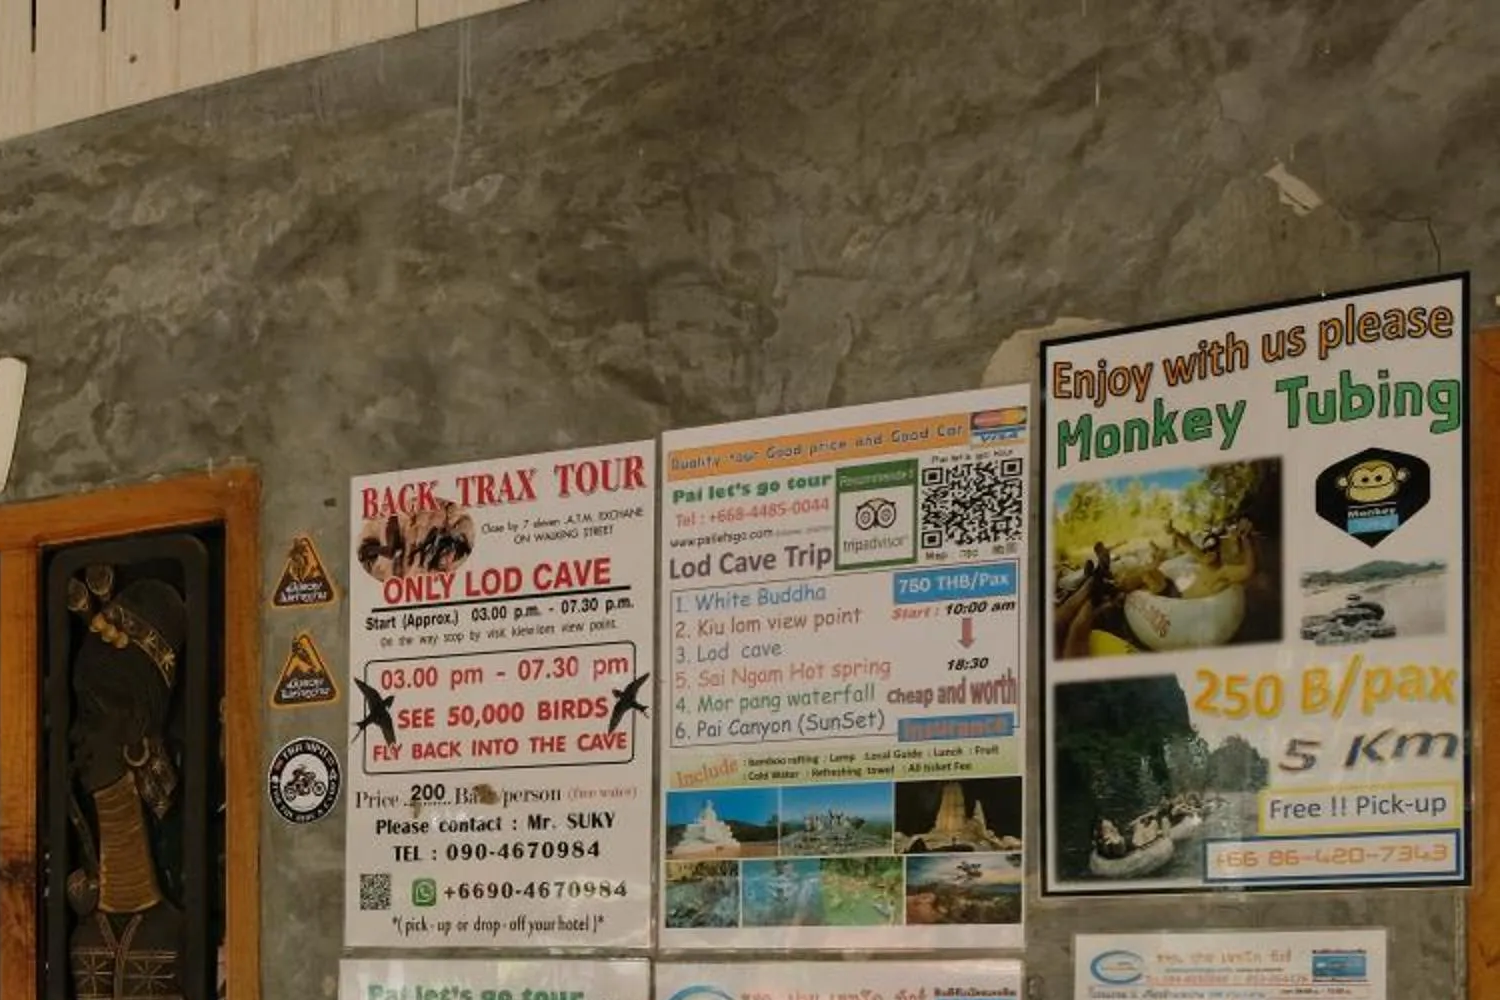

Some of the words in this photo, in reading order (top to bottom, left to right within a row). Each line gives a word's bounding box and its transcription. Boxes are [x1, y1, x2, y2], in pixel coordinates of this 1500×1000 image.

[1053, 358, 1154, 407] Enjoy
[1162, 332, 1249, 389] with
[1261, 324, 1306, 363] us
[1317, 304, 1454, 360] please
[1057, 397, 1246, 468] Monkey
[1276, 369, 1461, 435] Tubing
[361, 480, 438, 519] BACK
[456, 468, 538, 507] TRAX
[554, 456, 647, 497] TOUR
[708, 477, 752, 500] let's
[757, 479, 779, 498] go
[787, 474, 832, 491] tour
[514, 534, 530, 544] ON
[670, 554, 711, 579] Lod
[719, 554, 777, 574] Cave
[784, 545, 832, 570] Trip
[383, 572, 456, 605] ONLY
[465, 567, 522, 597] LOD
[532, 558, 610, 590] CAVE
[899, 578, 931, 593] 750
[937, 573, 1010, 592] THB/Pax
[695, 590, 750, 611] White
[757, 584, 826, 607] Buddha
[946, 601, 987, 615] 10:00
[366, 616, 396, 631] Start
[402, 611, 459, 630] (Approx.)
[561, 598, 598, 614] 07.30
[767, 611, 807, 630] view
[814, 607, 861, 629] point
[380, 667, 438, 691] 03.00
[451, 666, 483, 690] pm
[517, 656, 578, 680] 07.30
[593, 656, 628, 679] pm
[731, 665, 783, 687] Ngam
[789, 662, 825, 679] Hot
[831, 659, 891, 682] spring
[947, 657, 988, 671] 18:30
[788, 684, 876, 708] waterfall
[1194, 669, 1282, 719] 250
[1301, 653, 1458, 720] B/pax
[397, 709, 435, 729] SEE
[447, 703, 524, 728] 50,000
[537, 697, 609, 721] BIRDS
[697, 720, 724, 738] Pai
[729, 715, 792, 740] Canyon
[798, 709, 885, 734] (SunSet)
[373, 745, 402, 762] FLY
[411, 741, 461, 759] BACK
[471, 738, 519, 756] INTO
[530, 736, 566, 753] THE
[577, 732, 627, 751] CAVE
[1279, 737, 1321, 771] 5
[411, 784, 445, 801] 200
[1269, 798, 1321, 819] Free
[1356, 790, 1447, 818] Pick-up
[376, 819, 429, 835] Please
[440, 814, 502, 833] contact
[527, 814, 557, 831] Mr.
[567, 812, 615, 830] SUKY
[446, 841, 600, 861] 090-4670984
[1268, 843, 1448, 866] 86-420-7343
[444, 881, 627, 899] +6690-4670984
